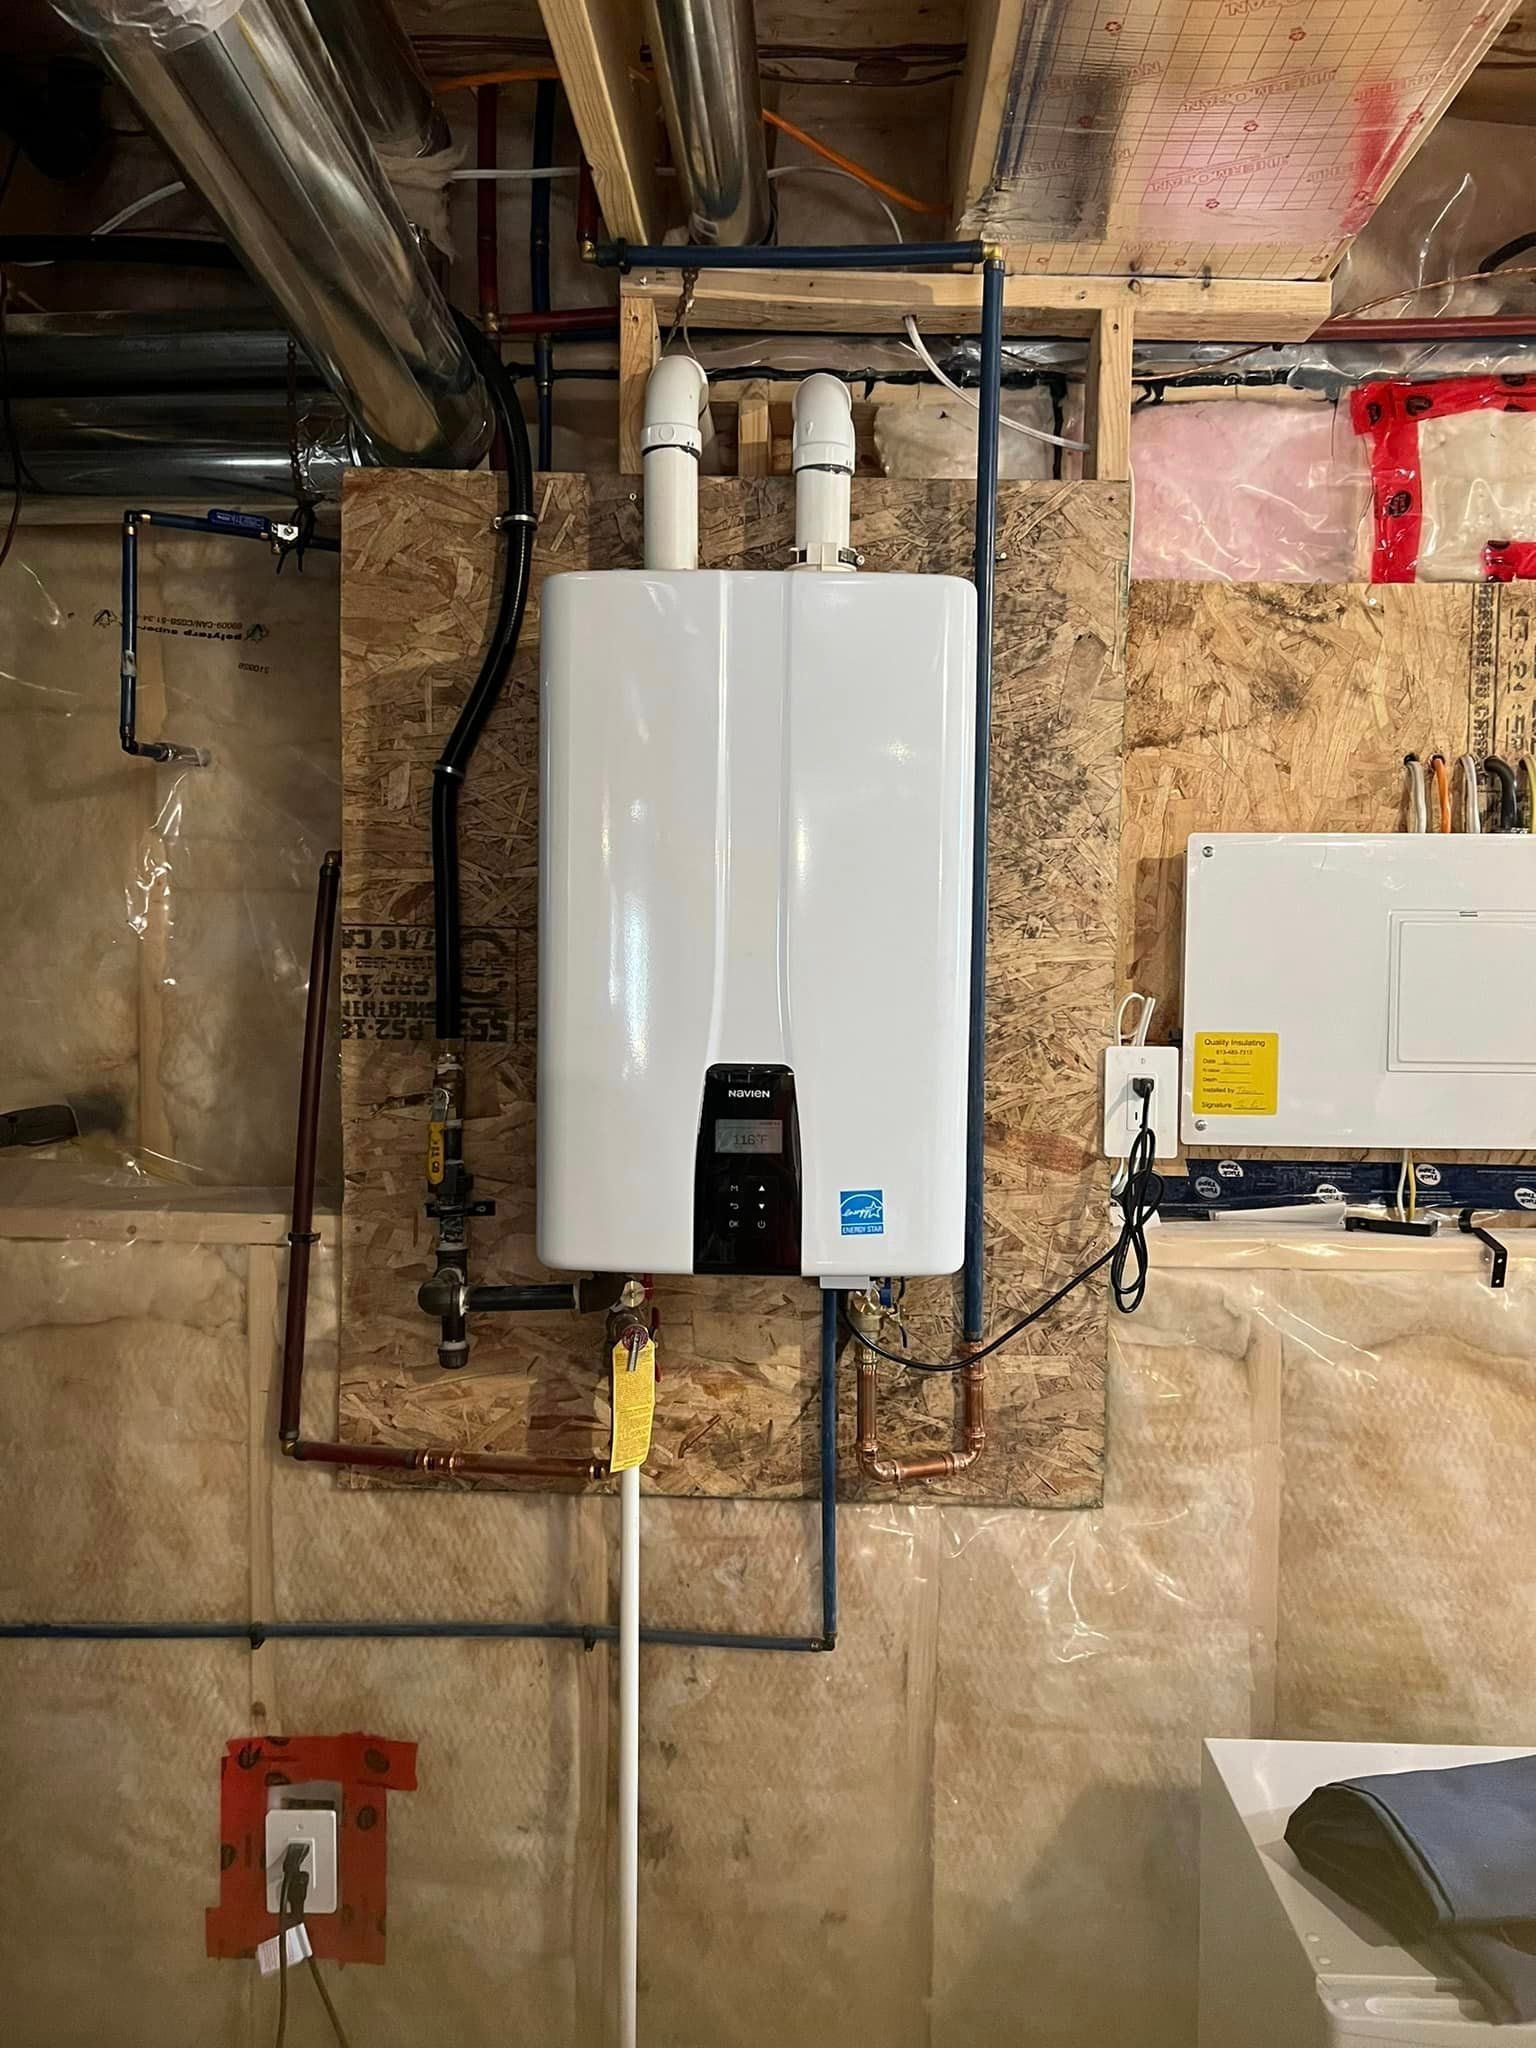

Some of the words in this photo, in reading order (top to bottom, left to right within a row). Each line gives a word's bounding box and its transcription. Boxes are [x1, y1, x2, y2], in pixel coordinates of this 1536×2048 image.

[1204, 1038, 1230, 1047] Quality
[1231, 1039, 1265, 1047] Insulating
[1417, 1167, 1436, 1175] Tape
[728, 1219, 740, 1228] OK
[842, 1226, 866, 1234] ENERGY
[867, 1225, 883, 1233] STAR
